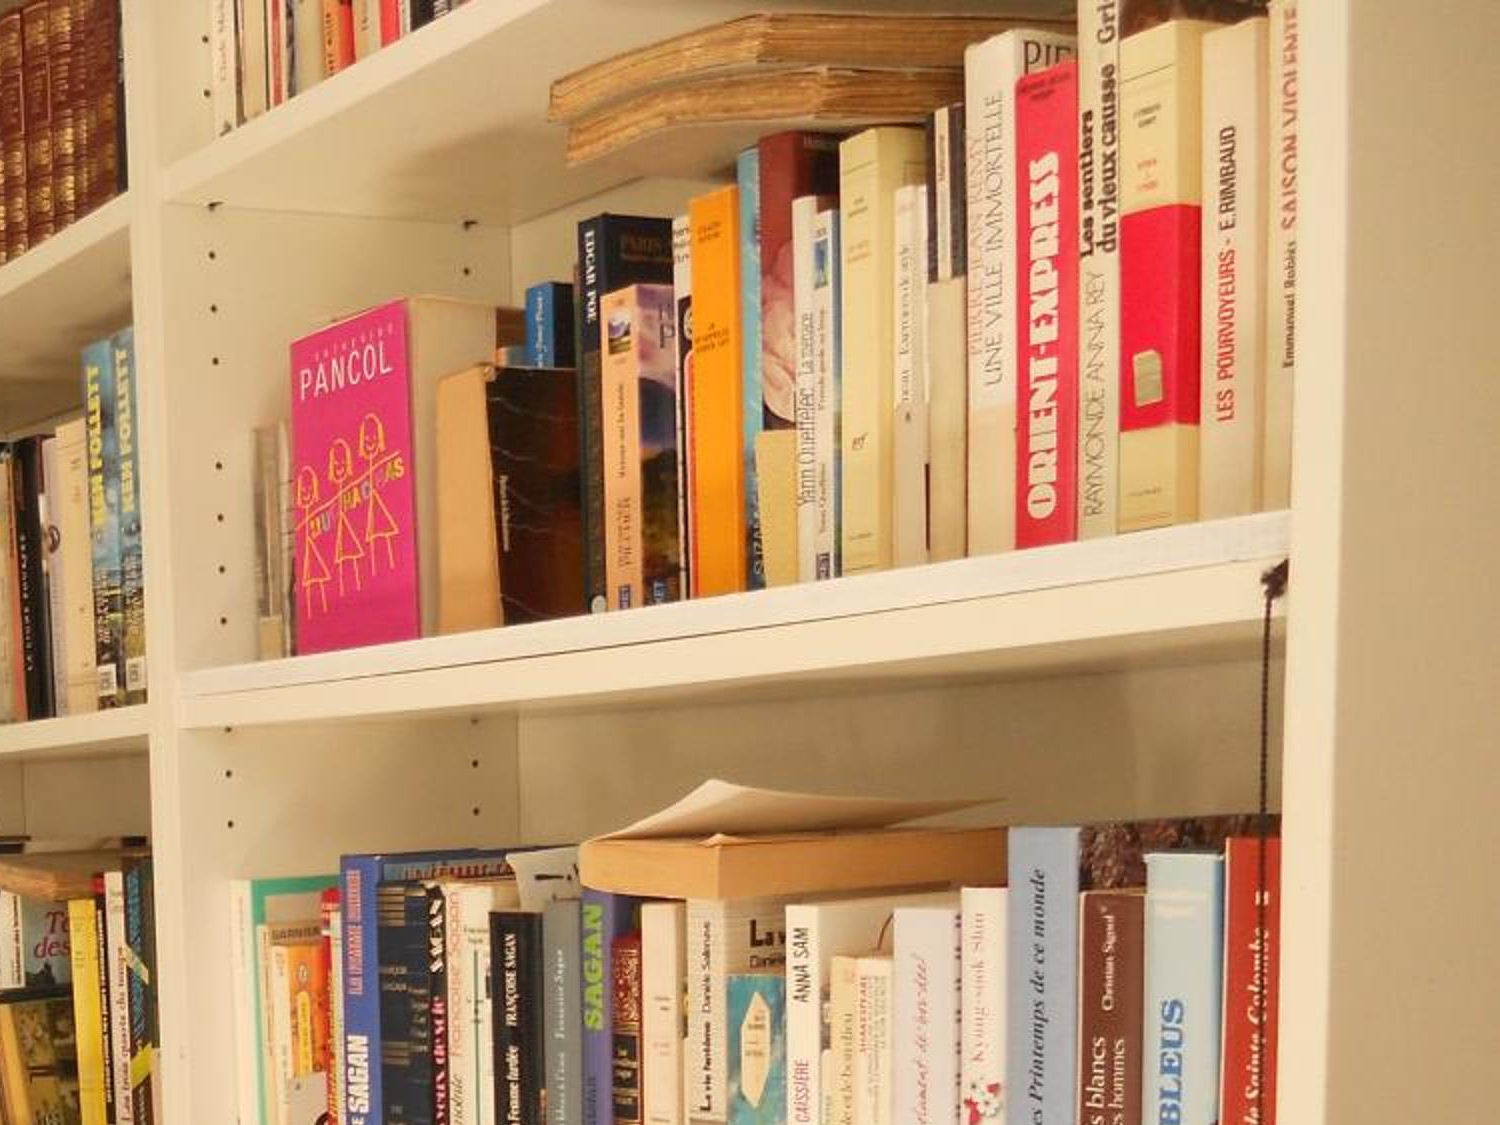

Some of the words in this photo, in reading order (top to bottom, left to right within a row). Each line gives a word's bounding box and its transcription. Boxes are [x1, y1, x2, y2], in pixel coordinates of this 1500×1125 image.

[1282, 7, 1299, 131] VIOLENTE
[1098, 63, 1117, 147] causse
[984, 94, 1004, 251] IMMORTELLE
[1078, 109, 1094, 213] sentiers
[1097, 155, 1117, 222] vieux
[1218, 125, 1236, 232] E.RIMBAUD
[1281, 135, 1298, 230] SAISON
[583, 229, 598, 285] EDGAR
[1079, 217, 1095, 258] Les
[1097, 226, 1117, 254] du
[584, 290, 598, 324] POE
[985, 263, 1003, 330] VILLE
[1088, 270, 1106, 308] REY
[1217, 248, 1236, 381] POURVOYEURS
[800, 312, 815, 358] menace
[1026, 151, 1060, 520] ORIENT-EXPRESS
[1087, 312, 1105, 383] ANNA
[1282, 292, 1296, 368] Emmanuel
[300, 339, 394, 401] PANCOL
[801, 359, 814, 377] La
[984, 331, 1003, 387] UNE
[87, 365, 102, 466] FOLLETT
[115, 349, 133, 457] FOLLETT
[1216, 389, 1234, 422] LES
[1083, 387, 1106, 517] RAYMONDE
[91, 474, 106, 530] KEN
[122, 460, 137, 513] KEN
[796, 465, 817, 507] Yann
[1031, 868, 1047, 938] monde
[429, 899, 445, 974] SAGAN
[504, 933, 517, 980] SAGAN
[749, 918, 774, 948] La
[793, 927, 810, 960] SAM
[971, 911, 985, 953] Shin
[1030, 942, 1045, 964] ce
[1103, 914, 1117, 954] Signol
[584, 903, 604, 1031] SAGAN
[793, 965, 811, 1003] ANNA
[1029, 971, 1045, 996] de
[1101, 953, 1115, 1012] Christian
[505, 981, 517, 1027] FRANÇOISE
[116, 1015, 131, 1058] quarts
[506, 1045, 520, 1082] fardée
[700, 1021, 712, 1072] fantôme
[1028, 1004, 1050, 1103] Printemps
[348, 1034, 369, 1114] SAGAN
[434, 1070, 447, 1119] yeux
[701, 1073, 712, 1091] vie
[793, 1057, 811, 1122] CAISSIÈRE
[1086, 1036, 1107, 1110] blancs
[1109, 1038, 1126, 1104] hommes
[507, 1083, 521, 1122] Femme
[699, 1094, 712, 1113] La
